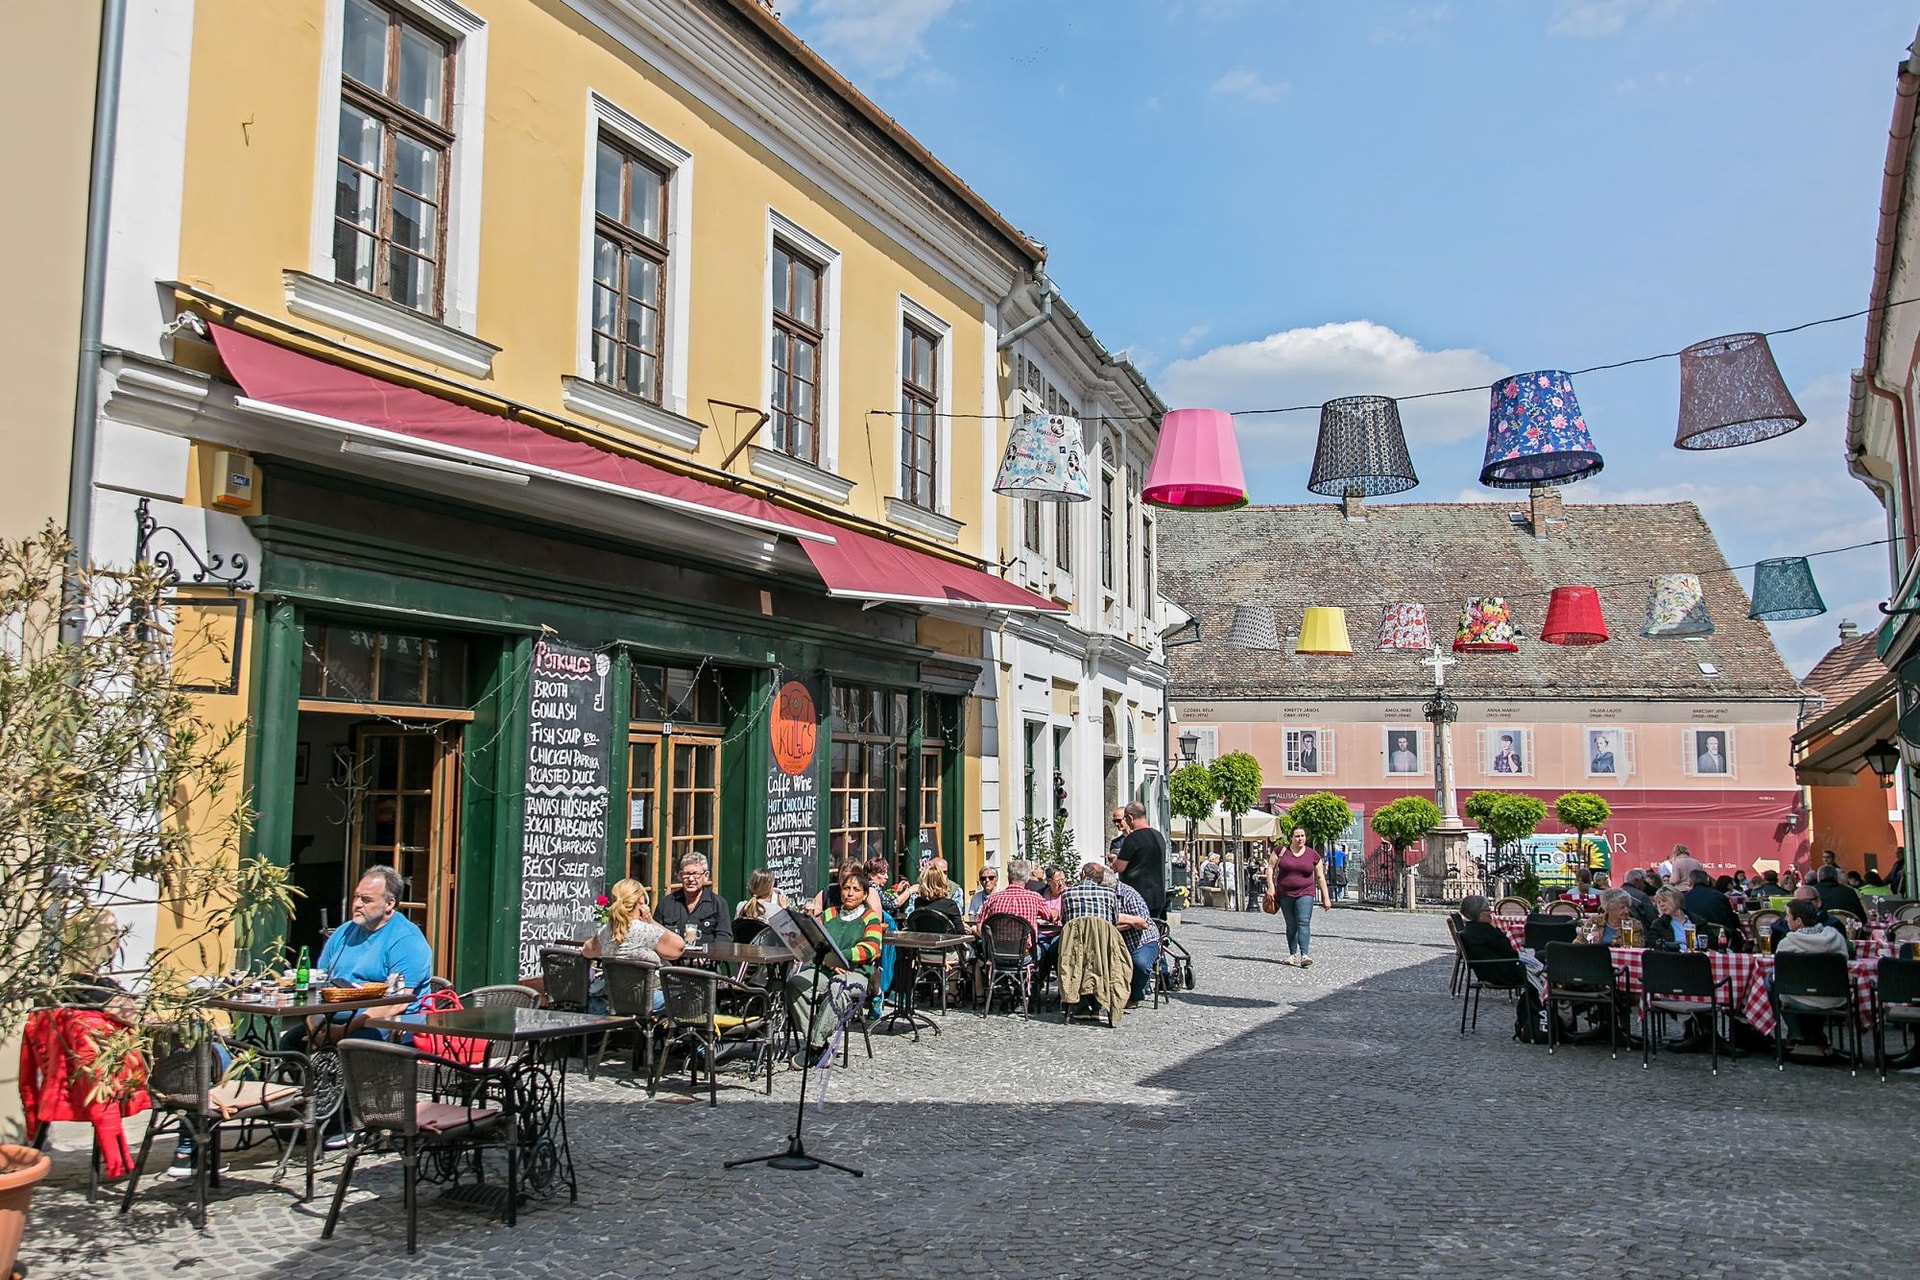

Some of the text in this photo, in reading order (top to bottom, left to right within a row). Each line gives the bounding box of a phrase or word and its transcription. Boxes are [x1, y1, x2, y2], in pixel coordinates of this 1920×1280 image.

[533, 679, 568, 698] BROTH
[531, 700, 577, 721] GOULASH
[530, 722, 555, 745] FISH
[556, 728, 582, 745] SOUP
[530, 746, 600, 770] CHICKEN PAPRIKA
[529, 765, 596, 785] ROASTED DUCK
[767, 773, 813, 797] Caffe Wine
[525, 796, 560, 816] TANYASI
[767, 795, 817, 814] HOT CHOCOLATE
[554, 817, 604, 838] BABGULYÁS
[766, 811, 813, 832] CHAMPAGNE
[766, 838, 787, 858] OPEN
[522, 854, 557, 878] BÉCSI
[558, 857, 590, 878] SZELET
[522, 880, 591, 901] SZTRAPACSKA
[519, 920, 577, 941] ESZTERHÁZY
[1538, 1009, 1549, 1033] FILA
